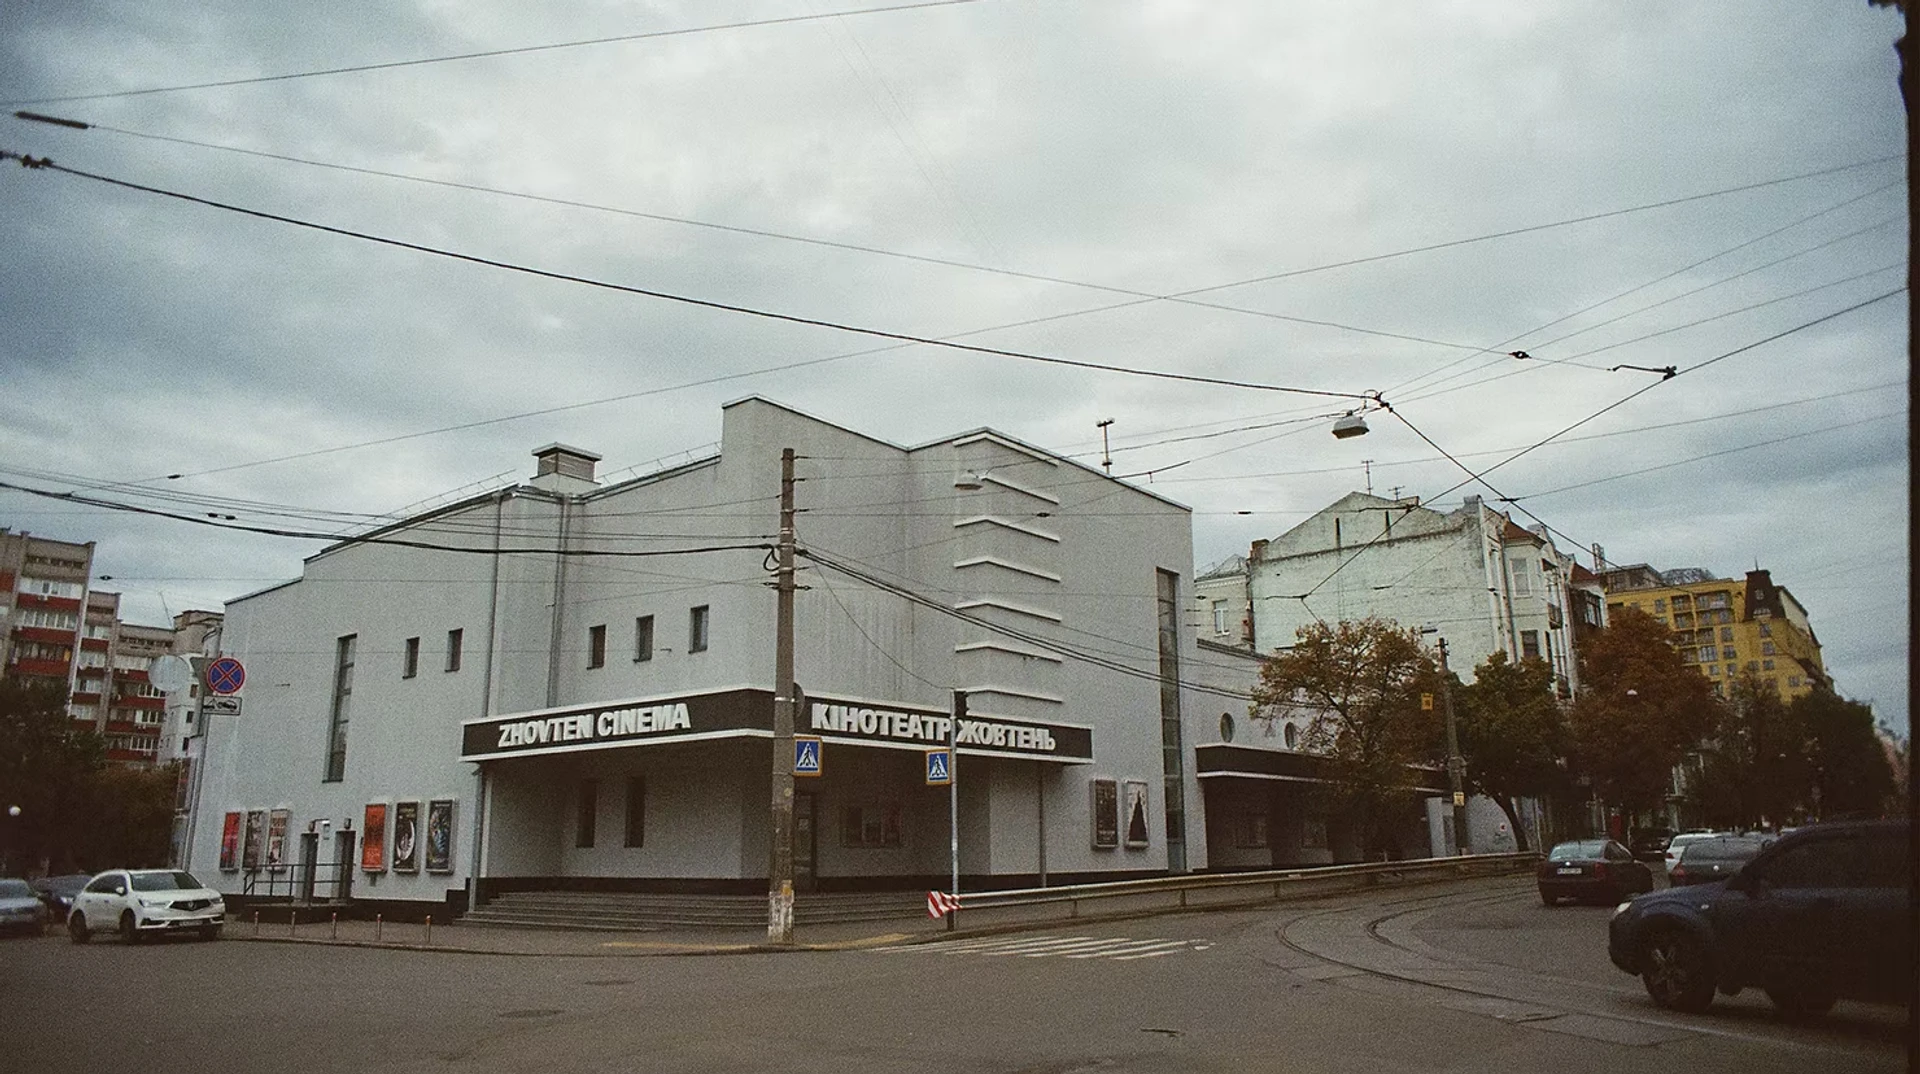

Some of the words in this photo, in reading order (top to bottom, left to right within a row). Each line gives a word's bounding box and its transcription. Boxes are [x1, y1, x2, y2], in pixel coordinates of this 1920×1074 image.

[498, 714, 594, 747] ZHOVTEN
[598, 703, 691, 737] CINEMA
[811, 703, 951, 741] КІНОТЕАТР
[956, 719, 1056, 750] ЖОВТЕНЬ
